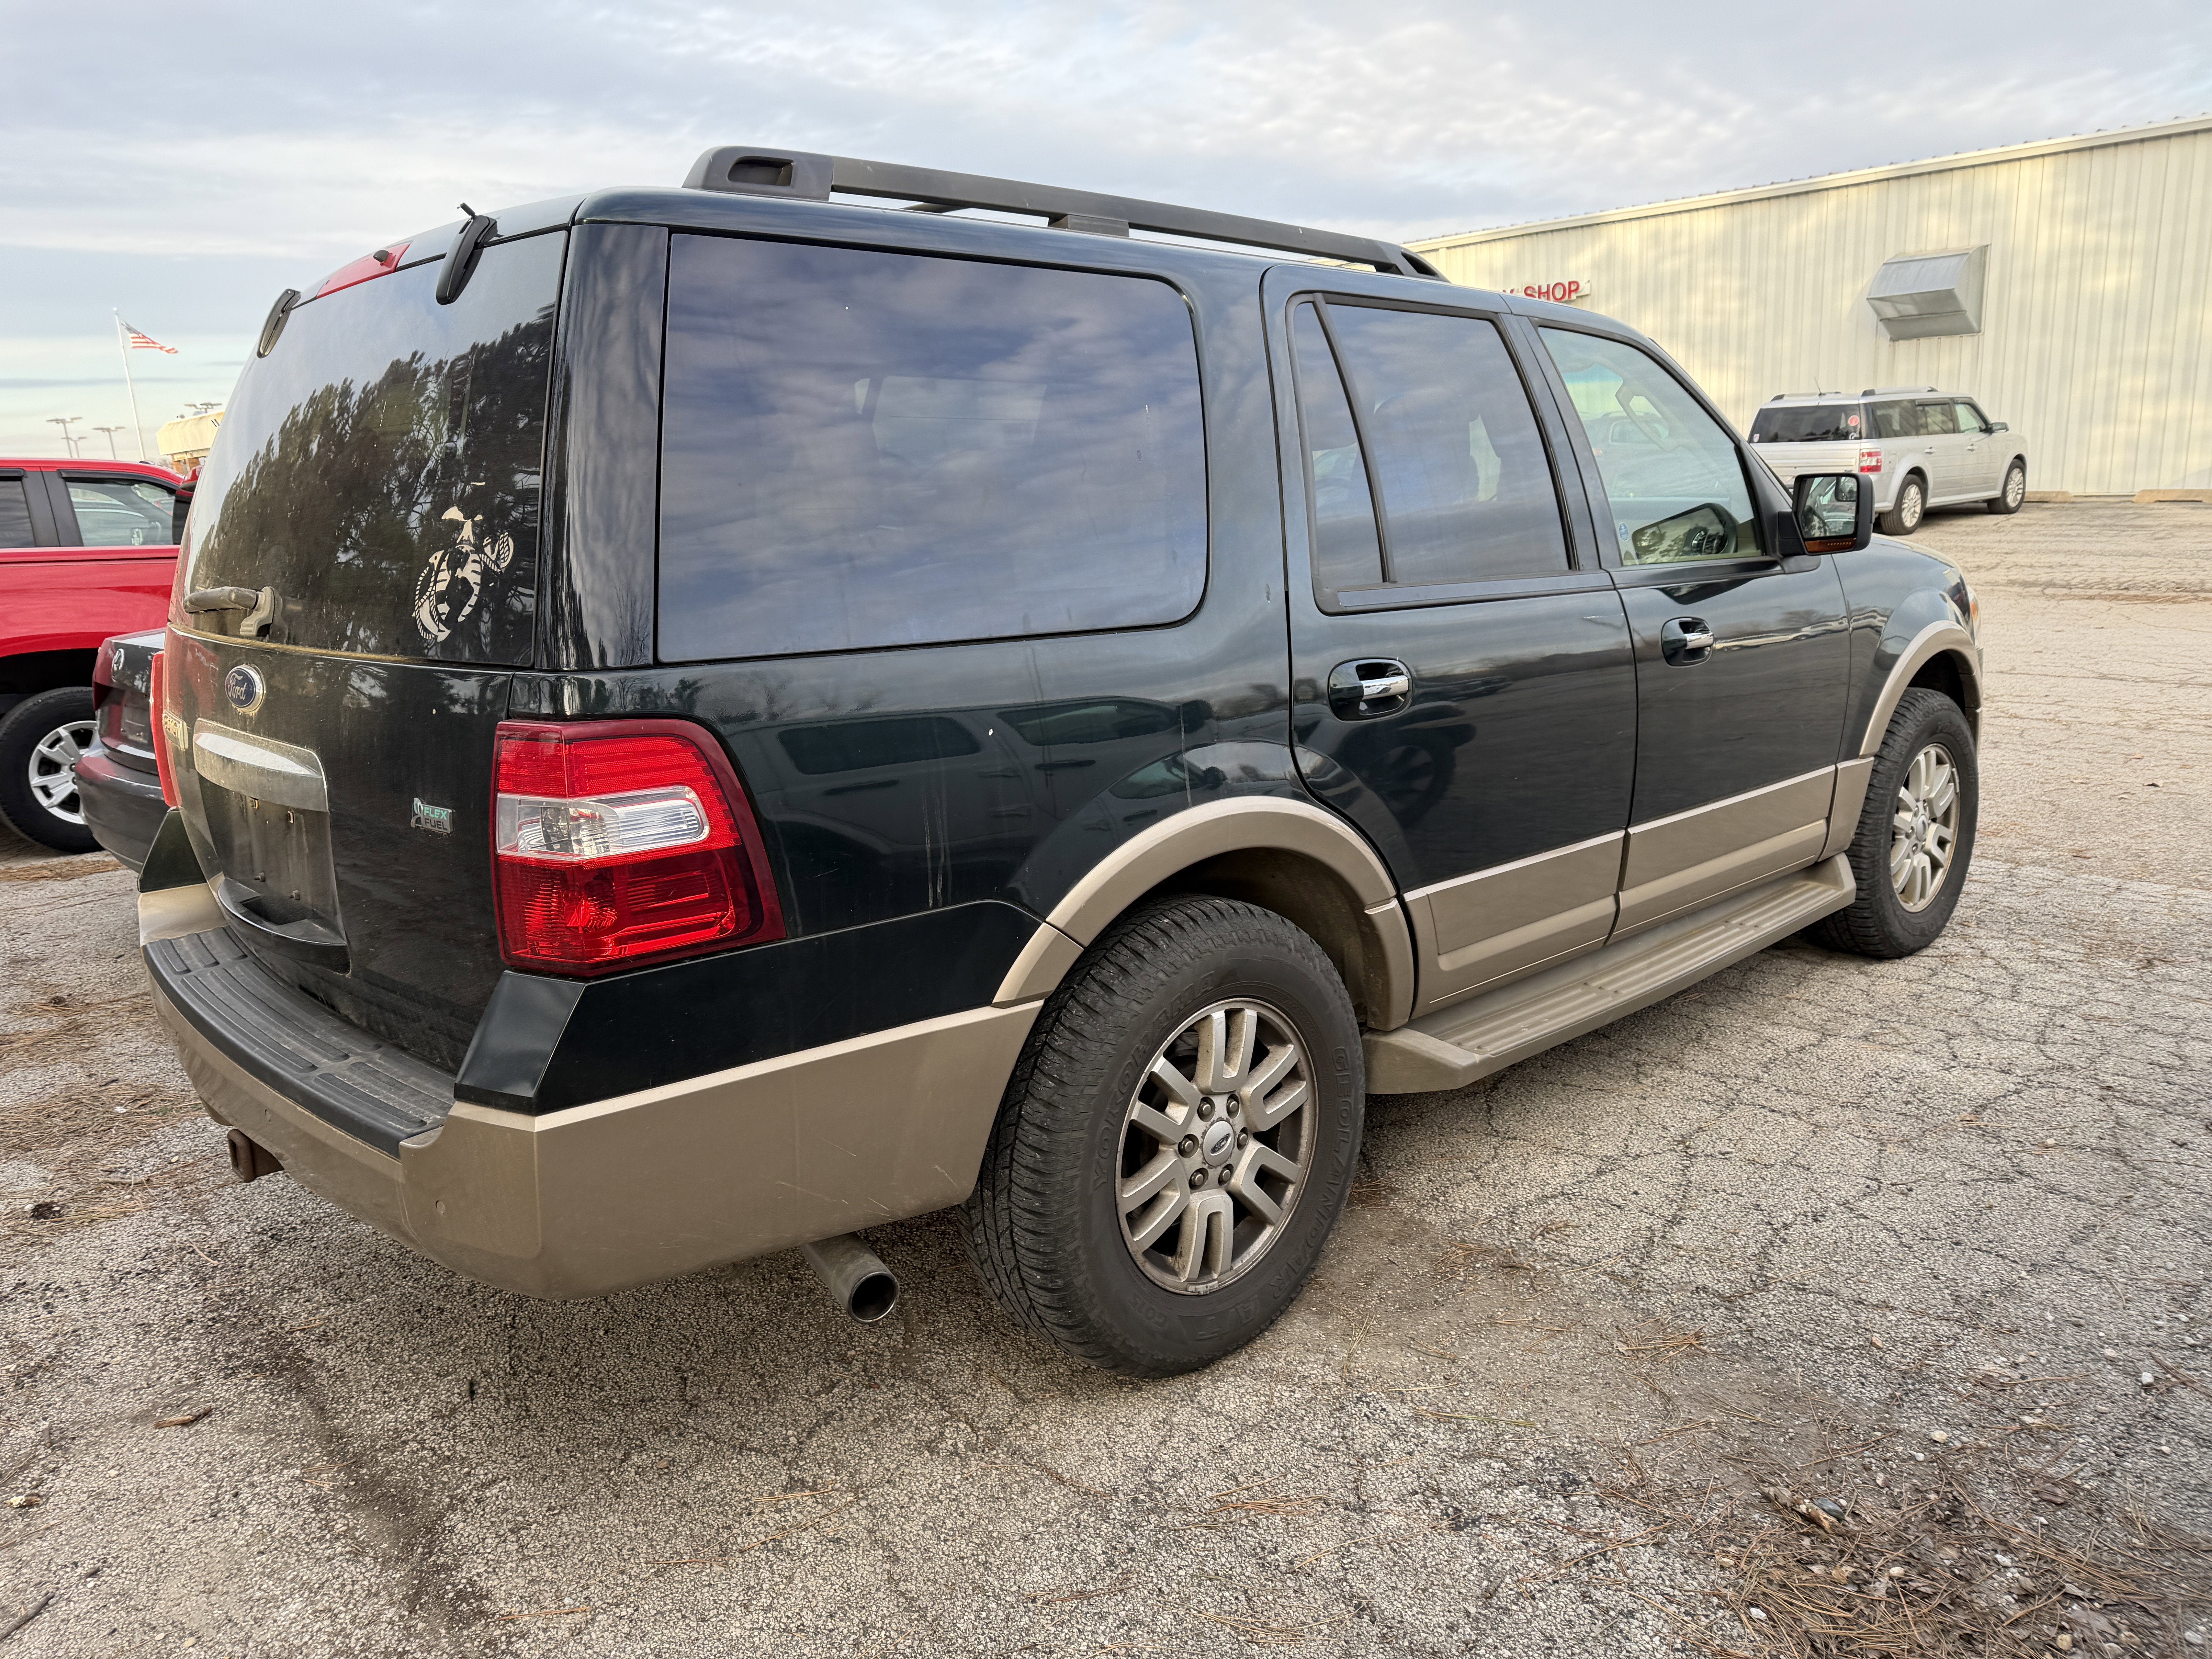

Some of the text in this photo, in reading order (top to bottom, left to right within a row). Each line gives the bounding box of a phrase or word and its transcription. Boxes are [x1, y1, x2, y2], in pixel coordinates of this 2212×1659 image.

[1524, 280, 1580, 301] SHOP
[228, 673, 247, 700] Ford
[424, 806, 447, 820] FLEX
[424, 817, 448, 831] FUEL
[1092, 971, 1215, 1191] YOKOHAMA
[1269, 1046, 1352, 1299] GEOLANDAR
